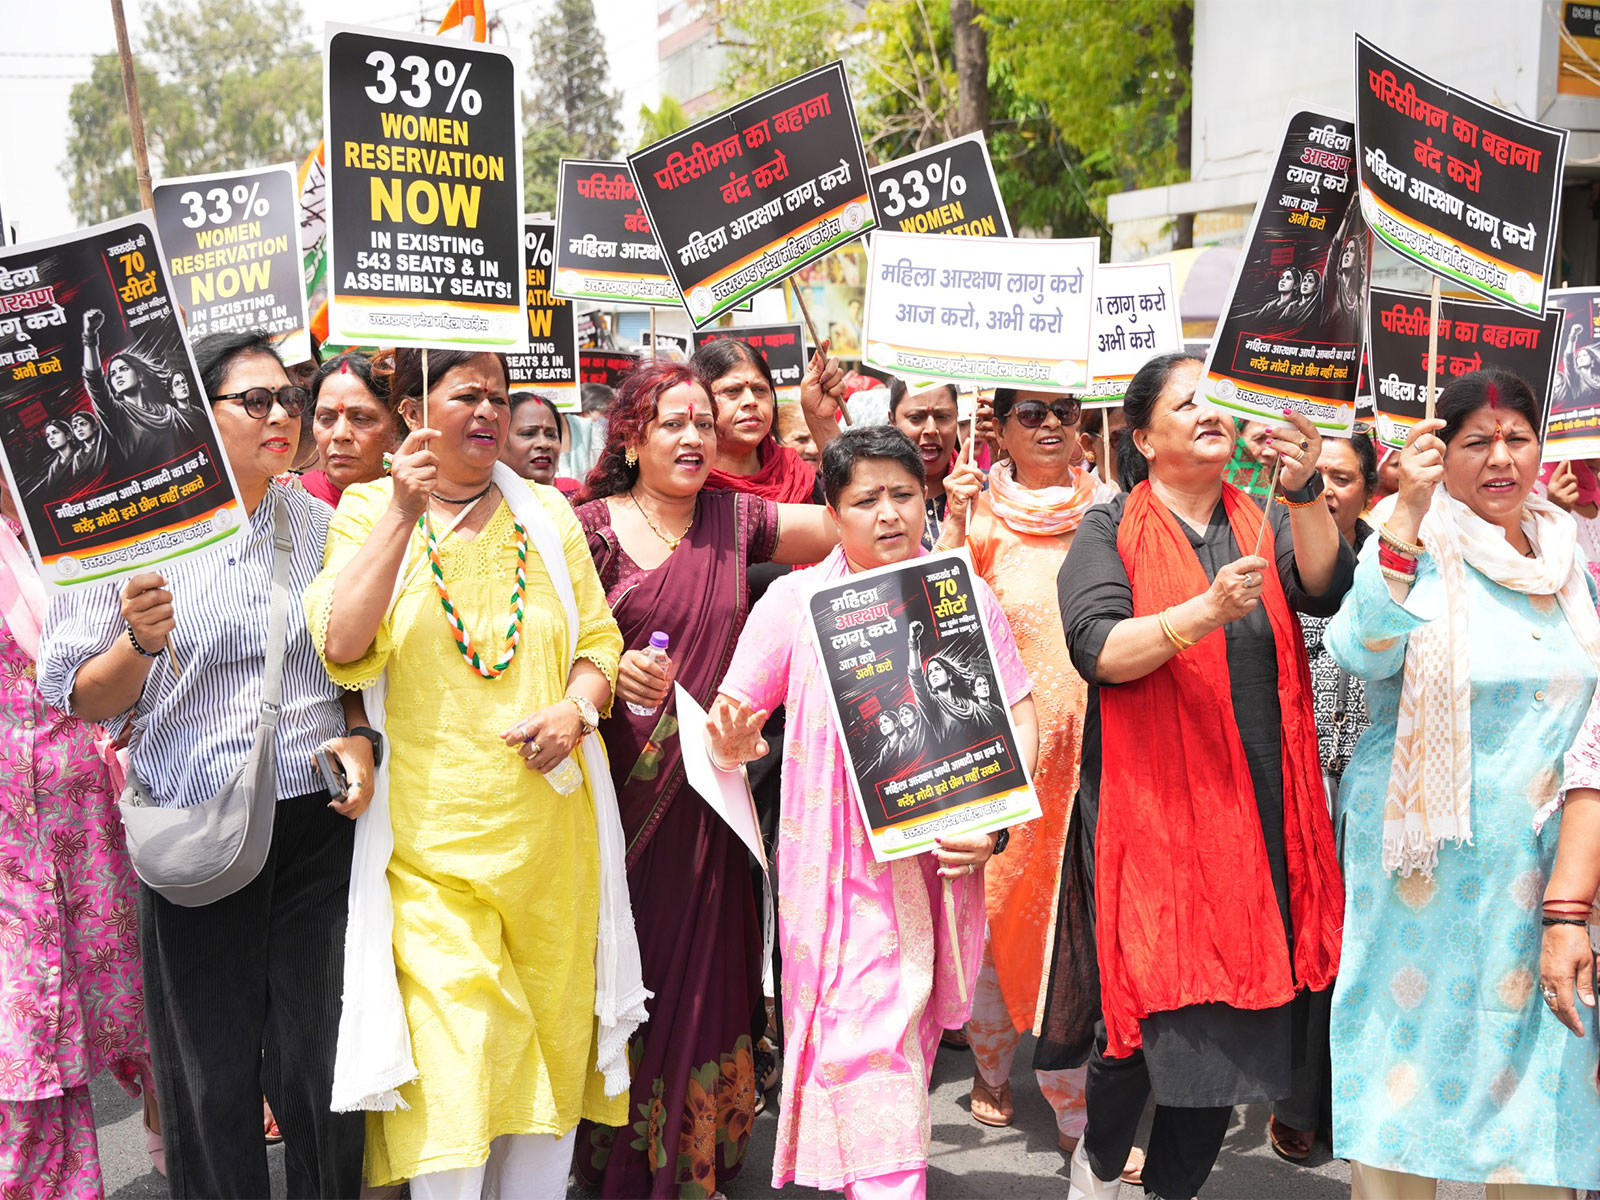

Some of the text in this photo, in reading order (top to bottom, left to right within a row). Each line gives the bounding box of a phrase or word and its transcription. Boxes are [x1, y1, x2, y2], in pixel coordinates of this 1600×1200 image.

[1572, 7, 1591, 19] DCB
[365, 51, 482, 115] 33%
[381, 112, 468, 146] WOMEN
[1369, 69, 1542, 173] परिसीमन का बहाना
[654, 93, 831, 191] परिसीमन का बहाना
[1308, 125, 1351, 150] महिला
[344, 142, 504, 181] RESERVATION
[1300, 148, 1351, 171] आरक्षण
[1414, 137, 1482, 193] बंद करो
[720, 150, 790, 204] बंद करो
[879, 157, 967, 217] 33%
[1287, 165, 1348, 194] लागू करो
[180, 182, 269, 228] 33%
[370, 177, 481, 228] NOW
[677, 159, 851, 265] महिला आरक्षण लागू करो
[1279, 195, 1318, 213] आज करो
[1365, 145, 1536, 251] महिला आरक्षण लागू करो
[899, 200, 964, 234] WOMEN
[1288, 212, 1326, 230] अभी करो
[136, 234, 146, 247] की
[196, 221, 261, 249] WOMEN
[371, 231, 483, 255] IN EXISTING
[569, 234, 617, 258] महिला
[119, 252, 145, 276] 70
[171, 235, 287, 276] RESERVATION
[357, 251, 498, 277] 543 SEATS & IN
[712, 264, 758, 300] उत्तराखण्ड
[756, 252, 782, 277] प्रदेश
[780, 236, 811, 264] महिला
[1418, 233, 1444, 260] प्रदेश
[1443, 245, 1475, 277] महिला
[119, 270, 157, 302] सीटों
[191, 259, 271, 305] NOW
[344, 272, 445, 294] ASSEMBLY
[450, 277, 511, 299] SEATS!
[882, 258, 1084, 304] महिला आरक्षण लागु करो
[24, 304, 67, 329] करो
[193, 294, 275, 322] IN EXISTING
[896, 301, 1063, 333] आज करो, अभी करो
[1106, 296, 1137, 323] लागु
[1139, 286, 1166, 311] करो
[211, 305, 287, 333] SEATS & IN
[1098, 324, 1155, 352] अभी करो
[1245, 338, 1271, 353] महिला
[1271, 344, 1298, 356] आरक्षण
[1299, 346, 1316, 358] आधी
[1316, 347, 1335, 359] आबादी
[1335, 350, 1343, 359] का
[1455, 321, 1540, 349] का बहाना
[16, 344, 39, 363] करो
[542, 356, 550, 366] &
[552, 356, 564, 366] IN
[950, 356, 976, 374] प्रदेश
[977, 358, 1013, 377] महिला
[1250, 356, 1348, 378] नरेंद्र मोदी इसे छीन नहीं सकते
[13, 356, 62, 380] अभी करो
[536, 368, 571, 379] SEATS!
[1236, 387, 1276, 406] उत्तराखण्ड
[1275, 396, 1295, 410] प्रदेश
[1379, 373, 1416, 401] महिला
[56, 503, 85, 519] महिला
[86, 494, 119, 511] आरक्षण
[120, 482, 141, 498] आधी
[142, 469, 171, 491] आबादी
[171, 464, 184, 478] का
[184, 459, 198, 473] हक
[73, 475, 204, 534] नरेंद्र मोदी इसे छीन नहीं सकते
[80, 549, 127, 569] उत्तराखण्ड
[127, 540, 152, 559] प्रदेश
[151, 528, 184, 550] महिला
[830, 587, 879, 611] महिला
[935, 579, 957, 598] 70
[835, 603, 889, 629] आरक्षण
[934, 594, 967, 617] सीटों
[830, 616, 897, 649] लागू करो
[839, 649, 876, 670] आज करो
[856, 658, 893, 679] अभी करो
[884, 781, 907, 795] महिला
[908, 771, 934, 788] आरक्षण
[934, 761, 950, 778] आधी
[973, 751, 984, 762] का
[897, 762, 1000, 808] नरेंद्र मोदी इसे छीन नहीं सकते
